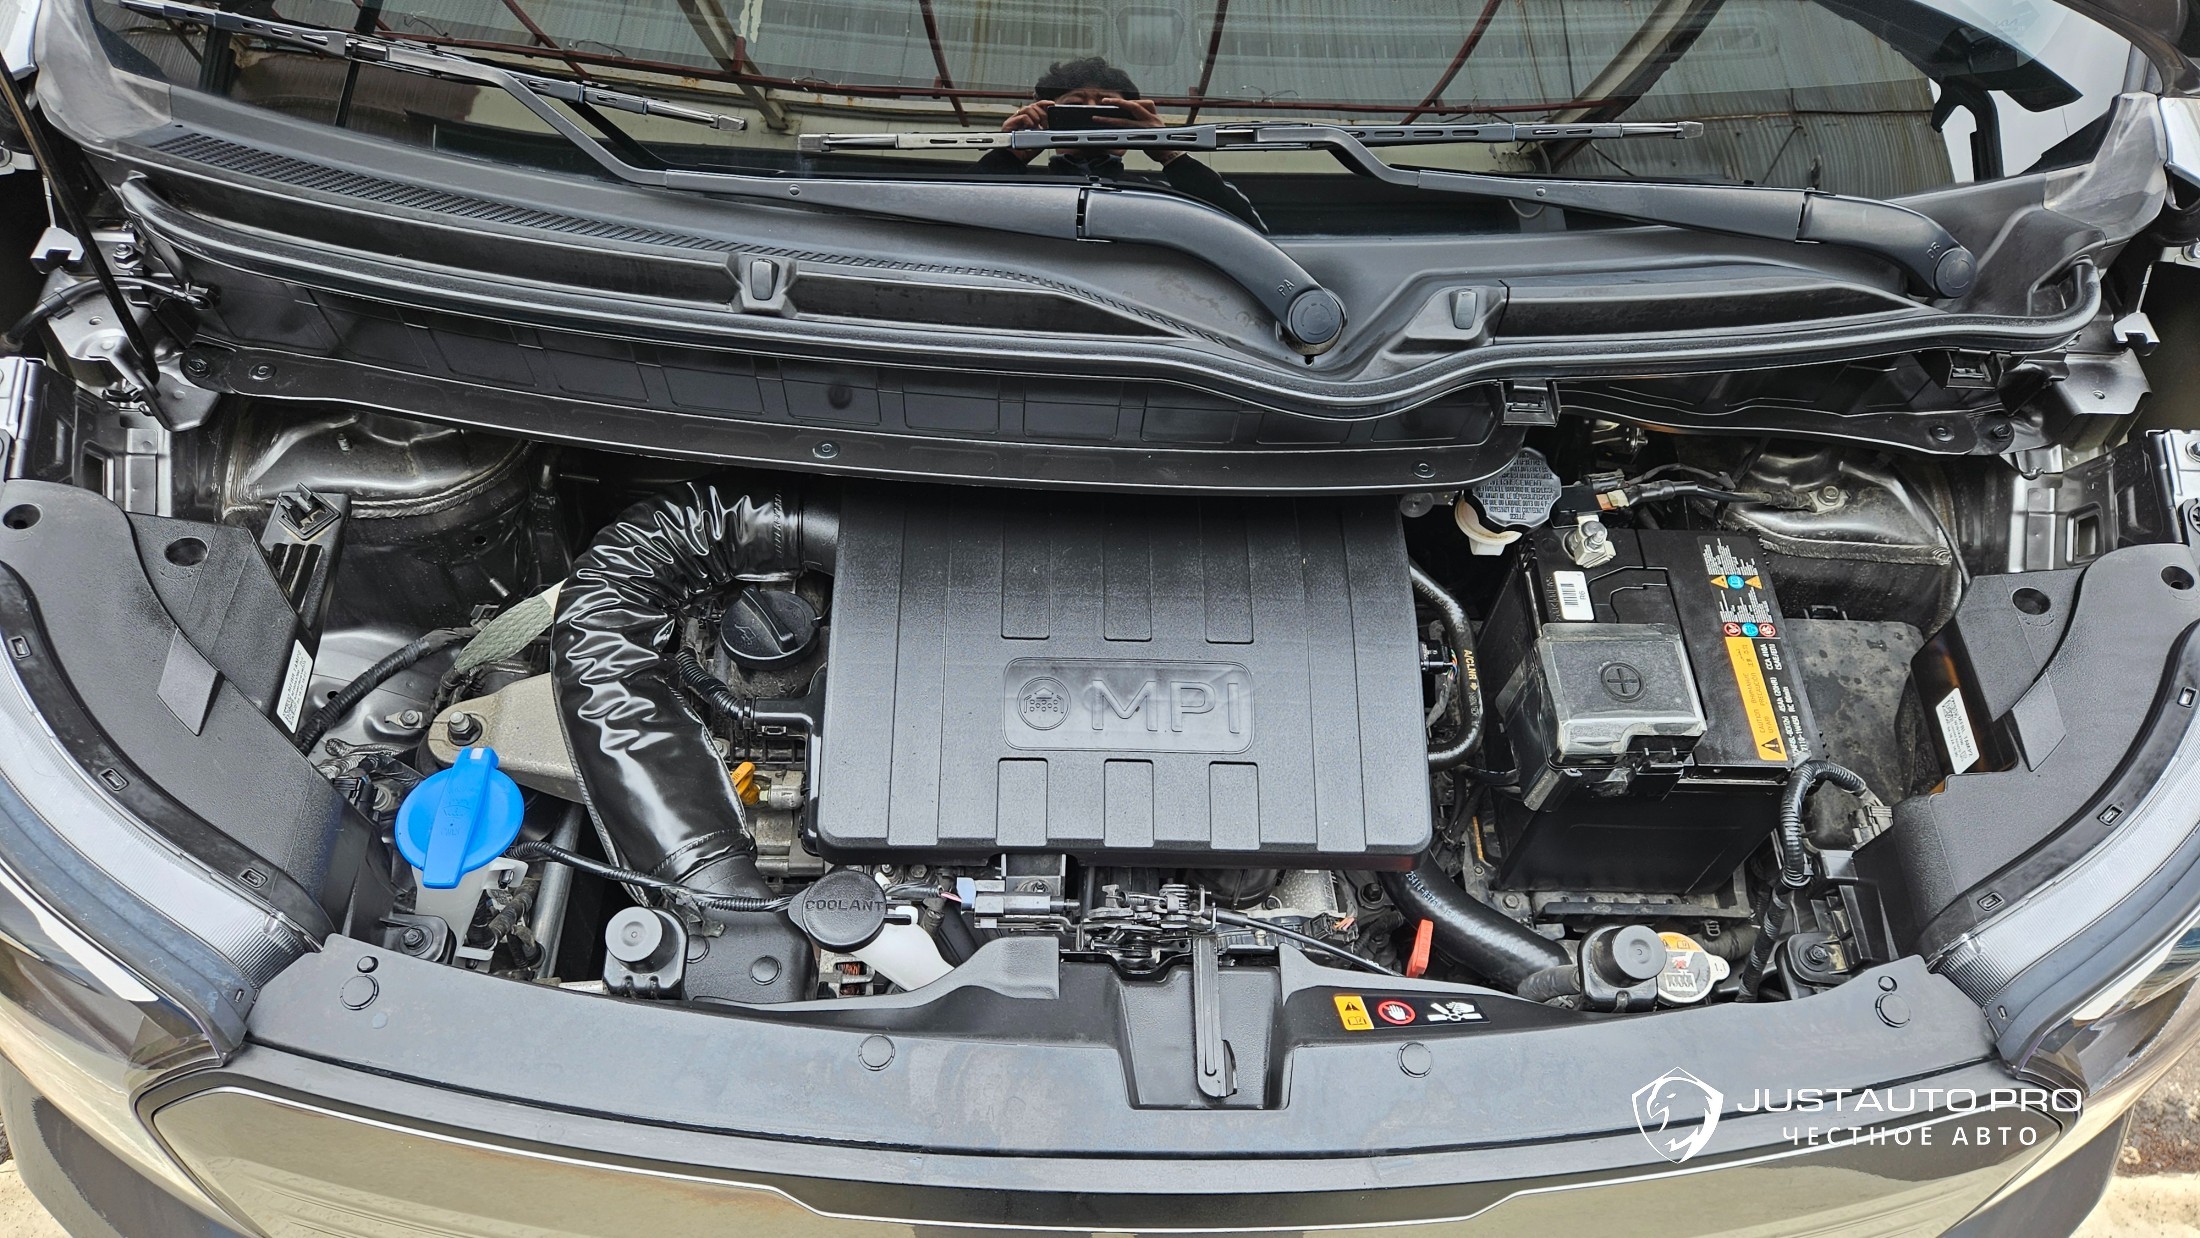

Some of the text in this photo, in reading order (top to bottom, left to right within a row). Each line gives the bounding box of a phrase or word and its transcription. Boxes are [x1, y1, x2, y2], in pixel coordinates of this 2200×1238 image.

[1276, 279, 1295, 297] PA
[1092, 679, 1240, 734] MPI
[1753, 708, 1766, 734] CAUTION
[1791, 715, 1809, 752] 7110-1W450
[805, 899, 884, 912] COOLANT
